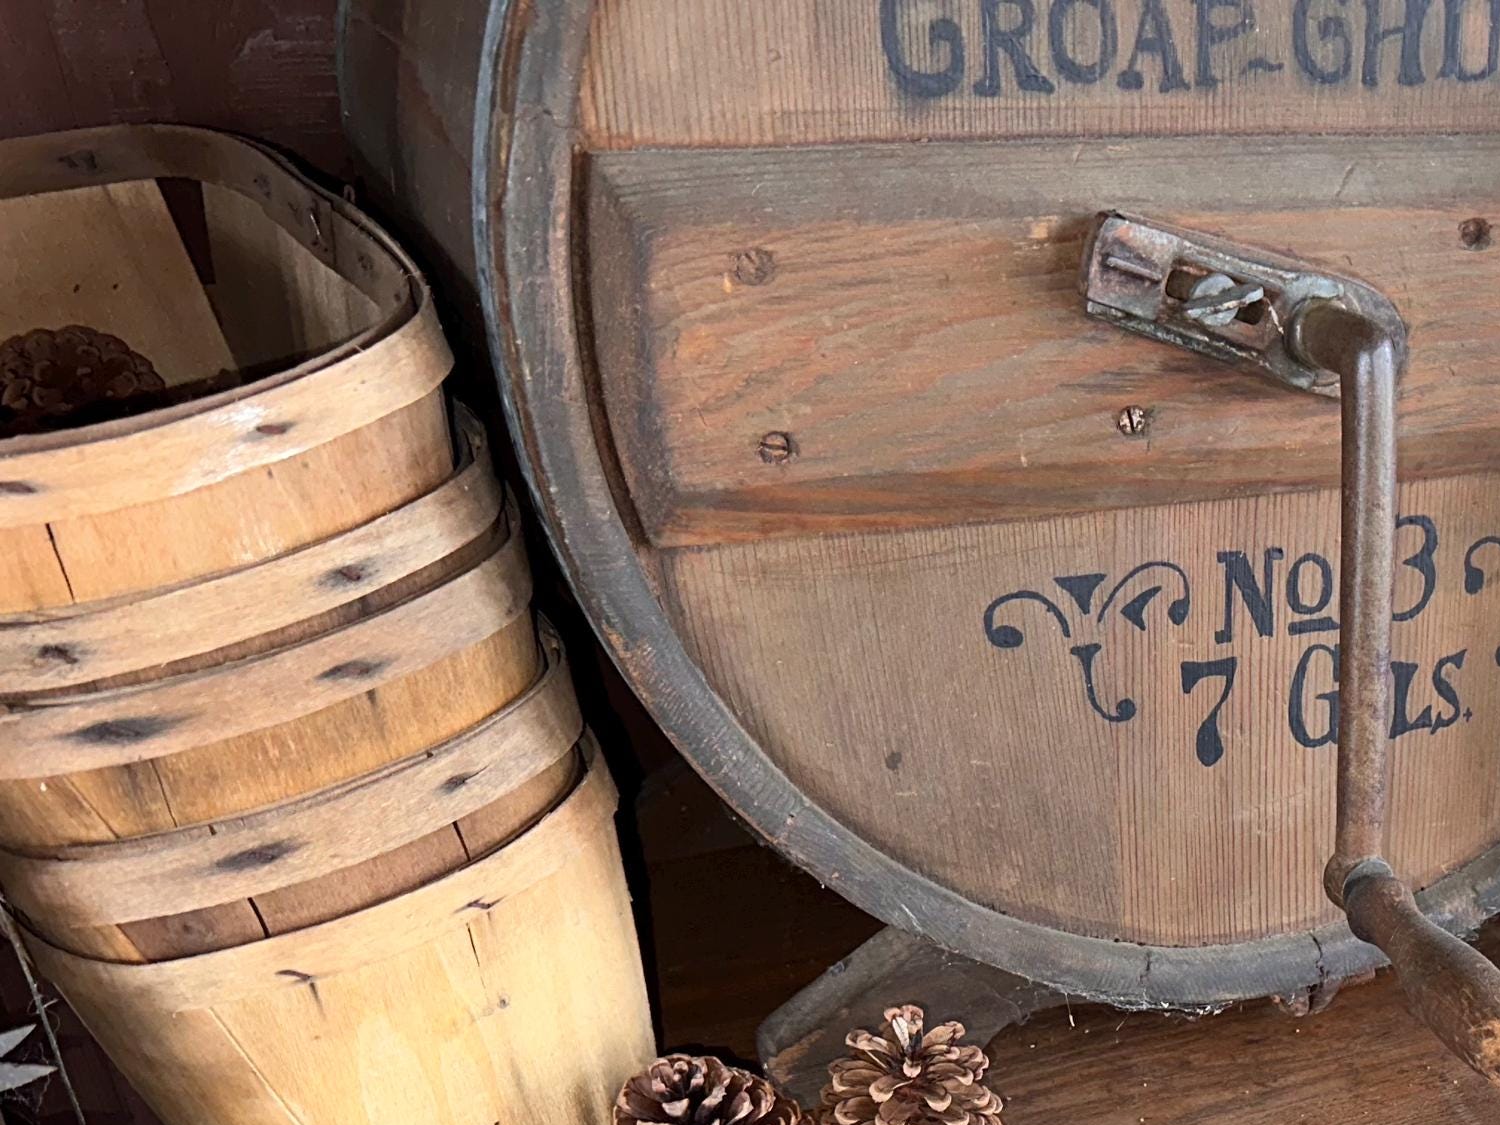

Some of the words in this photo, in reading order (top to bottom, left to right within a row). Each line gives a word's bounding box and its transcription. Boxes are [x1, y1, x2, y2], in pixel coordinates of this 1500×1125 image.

[1390, 513, 1438, 622] 3
[1180, 656, 1237, 766] 7
[1287, 644, 1474, 748] GLS.
